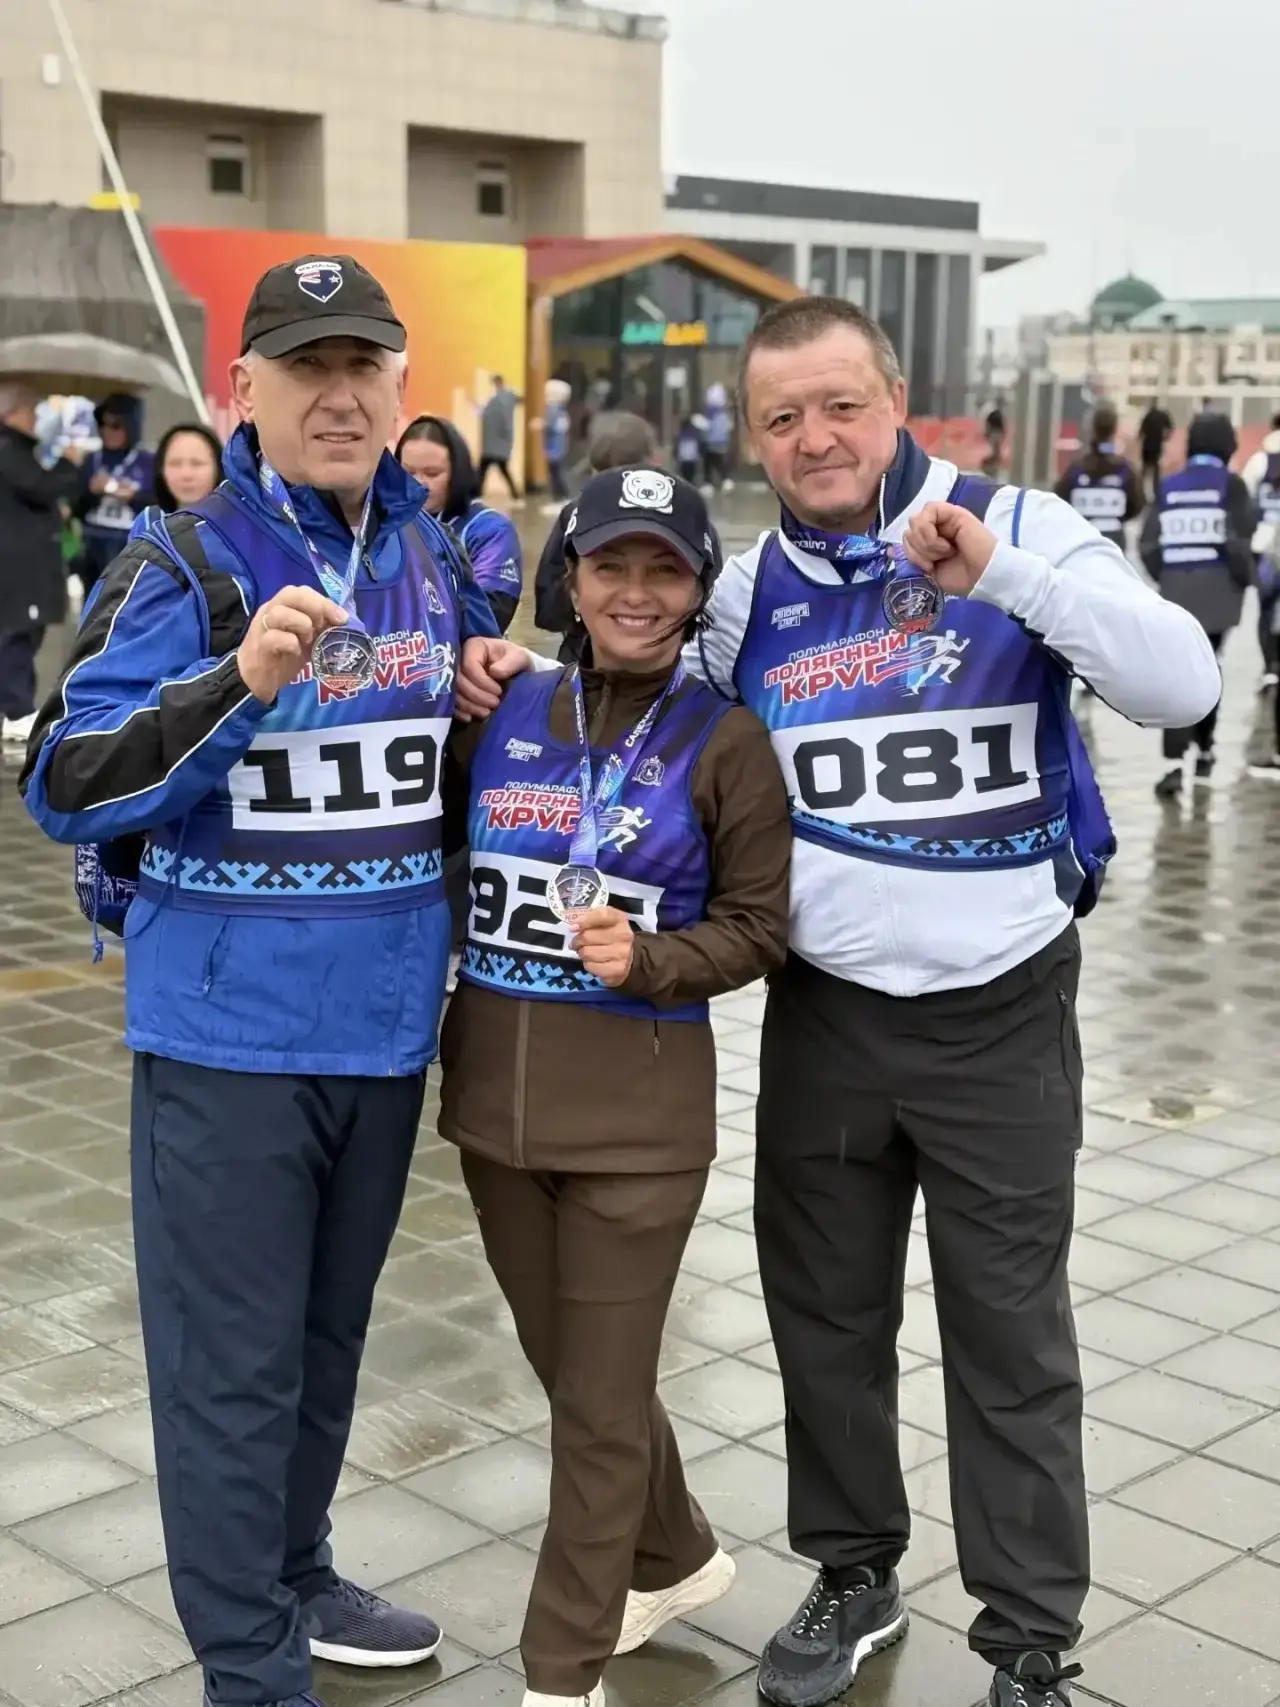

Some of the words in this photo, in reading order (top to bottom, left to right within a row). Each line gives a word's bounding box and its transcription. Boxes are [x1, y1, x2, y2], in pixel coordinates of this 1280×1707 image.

[764, 629, 907, 690] ПОЛЯРНЫЙ
[788, 628, 885, 662] ПОЛУМАРАФОН
[781, 654, 890, 707] КРУГ
[243, 734, 438, 813] 119
[504, 781, 581, 794] ПОЛУМАРАФО
[792, 722, 1030, 811] 081
[478, 789, 581, 811] ПОЛЯРНЫ
